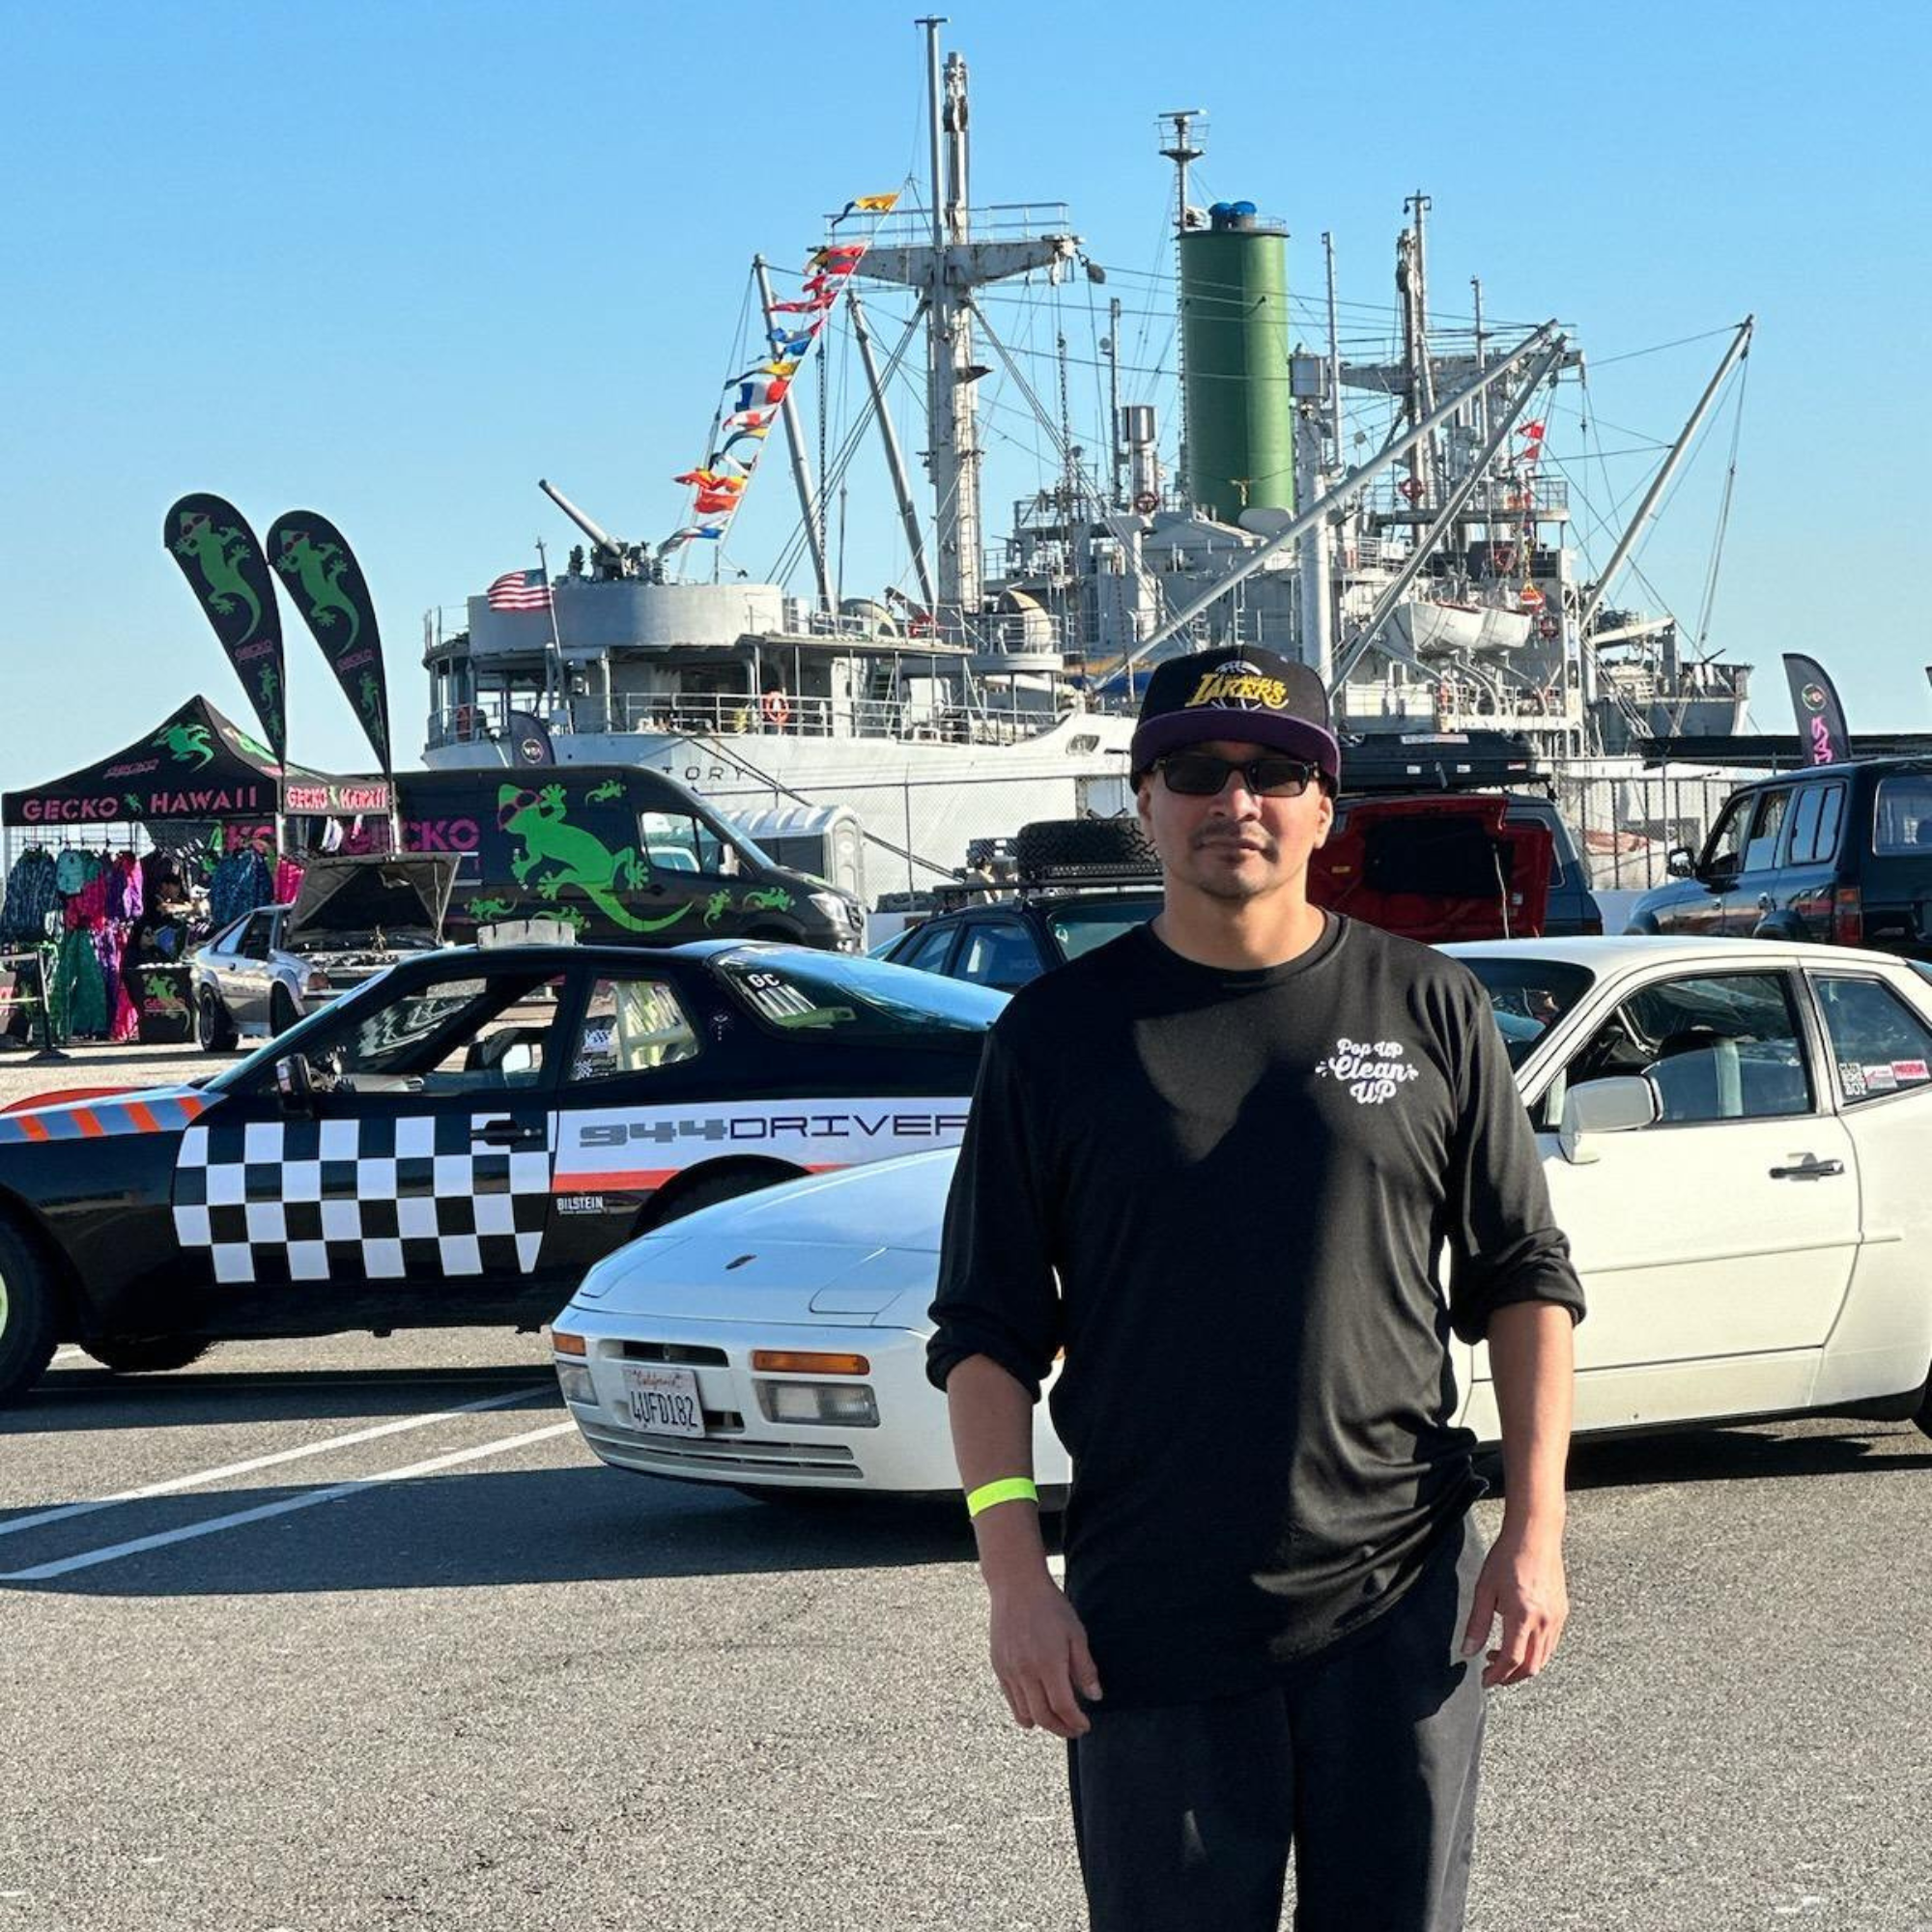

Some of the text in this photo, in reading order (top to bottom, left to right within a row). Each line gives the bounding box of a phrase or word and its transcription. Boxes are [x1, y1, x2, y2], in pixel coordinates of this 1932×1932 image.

[22, 786, 257, 820] GECKO HAWAII
[1337, 1037, 1373, 1059] Pop
[1327, 1055, 1407, 1081] Clean
[556, 1196, 604, 1211] BILSTEIN
[630, 1390, 698, 1428] 4UFD182
